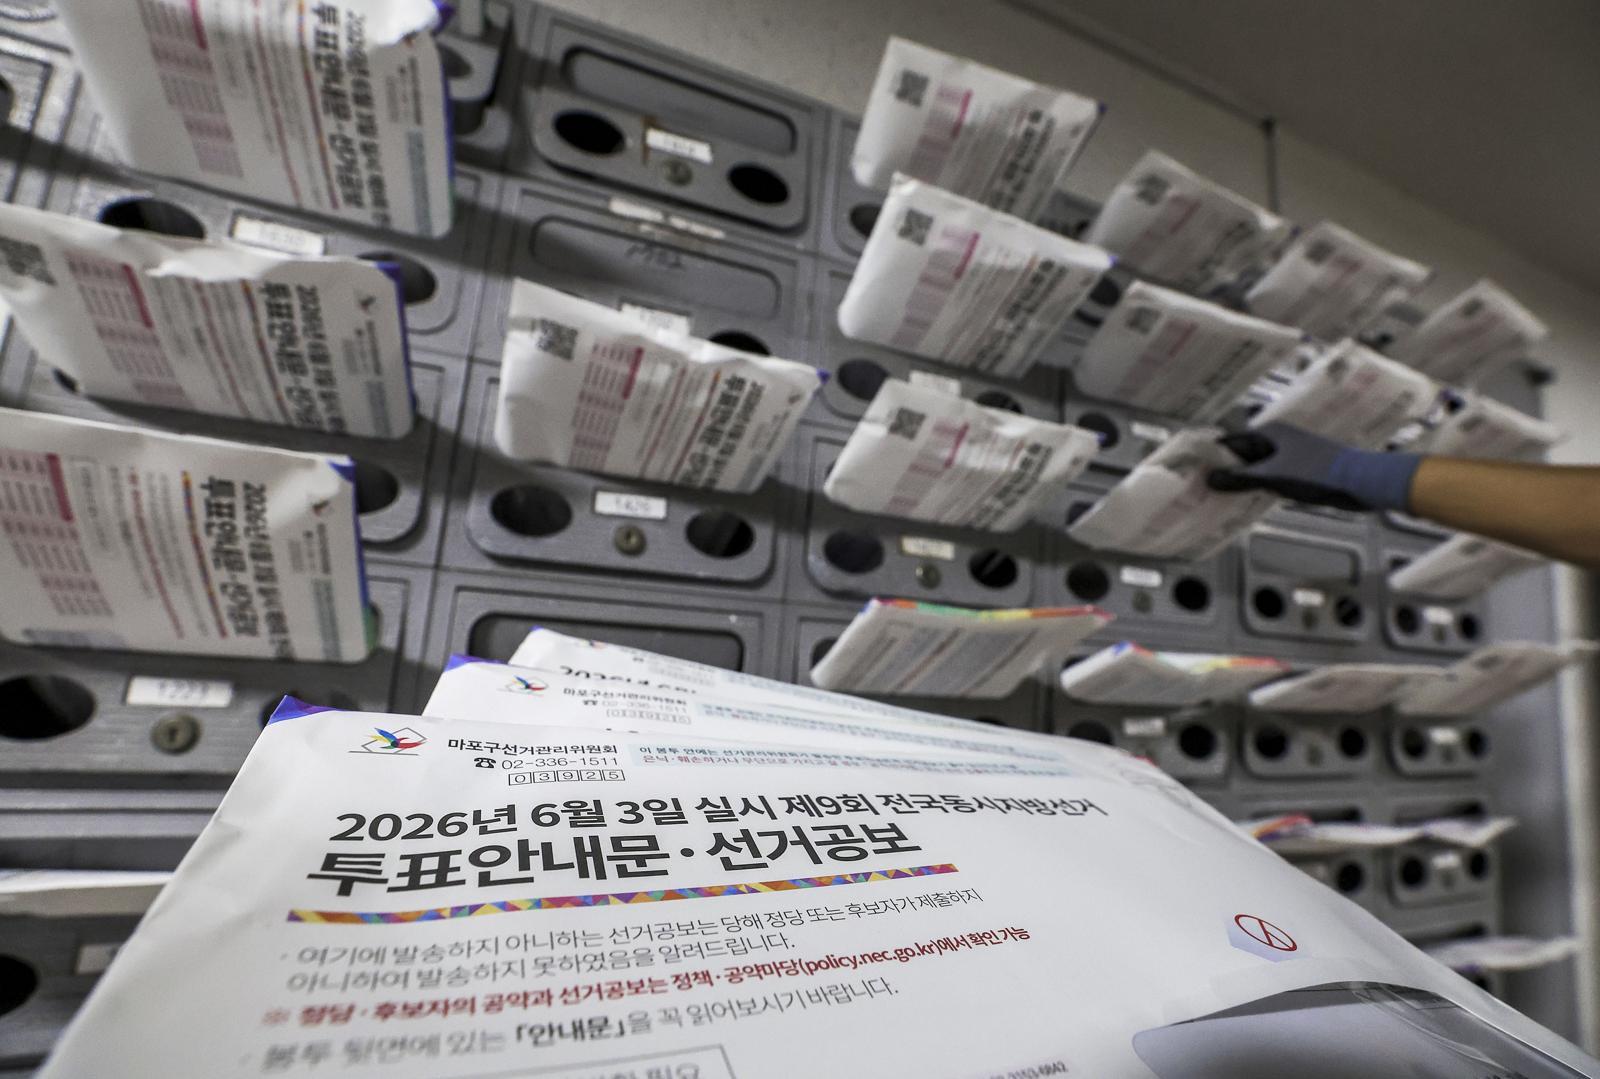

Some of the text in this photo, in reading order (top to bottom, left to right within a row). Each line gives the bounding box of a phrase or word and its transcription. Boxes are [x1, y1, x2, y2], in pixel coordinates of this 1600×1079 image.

[448, 738, 618, 755] 마포구선거관리위원회
[502, 756, 618, 770] 02-336-1511
[510, 770, 624, 785] 03925
[329, 793, 1109, 842] 2026년 6월 3일 실시 제9회 전국동시지방선거
[297, 945, 387, 966] 여기에
[393, 935, 499, 964] 발송하지
[504, 929, 603, 953] 아니하는
[609, 915, 718, 946] 선거공보는
[720, 912, 764, 935] 당해
[766, 909, 805, 928] 정당
[806, 905, 845, 925] 또는
[287, 932, 796, 994] 아니하여 발송하지 못하였음을 알려드립니다.
[446, 1028, 505, 1057] 있는
[658, 1006, 683, 1030] 꼭
[686, 987, 806, 1023] 읽어보시기
[805, 975, 900, 1010] 바랍니다.
[482, 990, 555, 1016] 공약과
[558, 973, 669, 1008] 선거공보는
